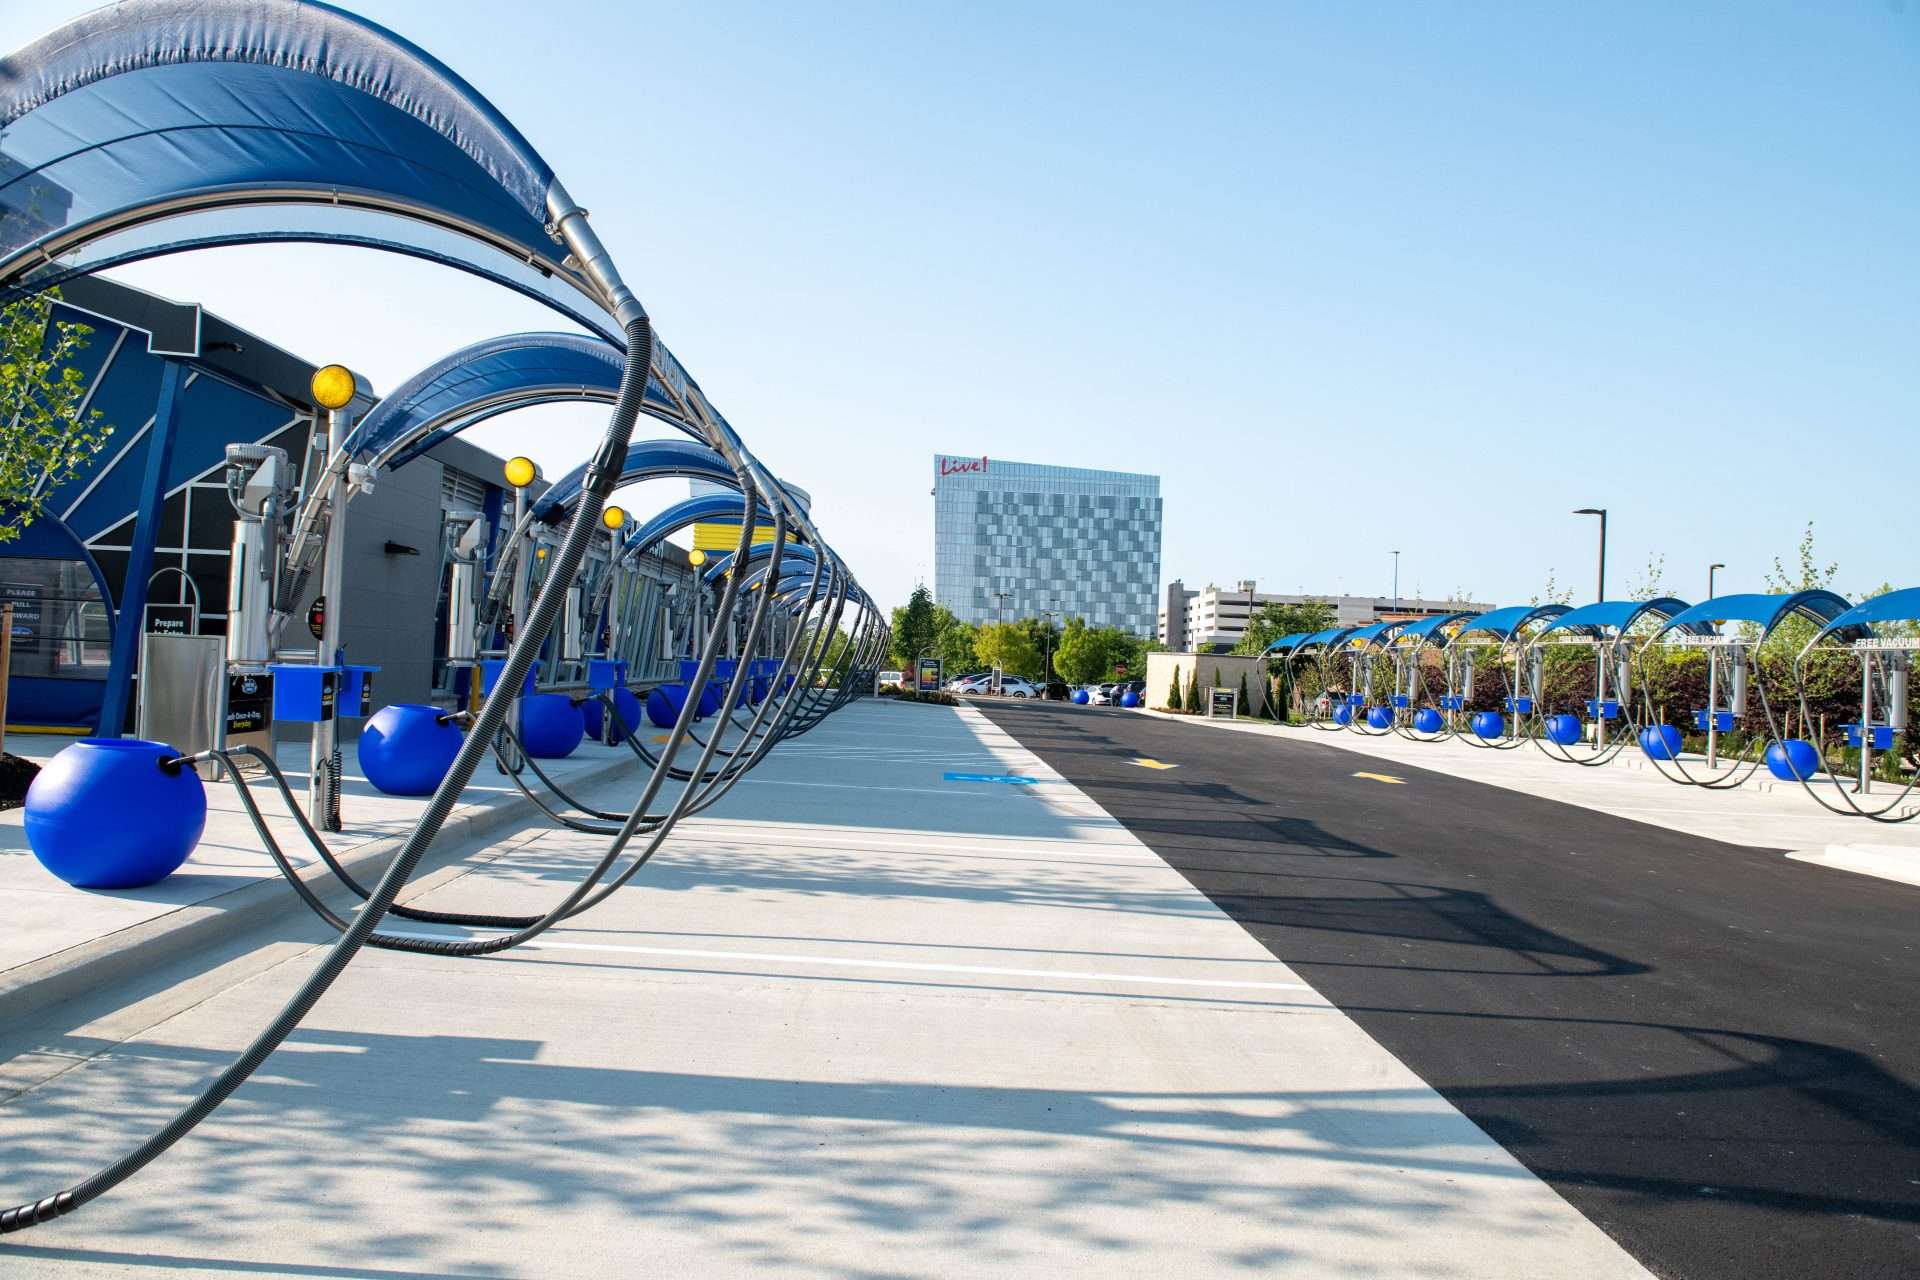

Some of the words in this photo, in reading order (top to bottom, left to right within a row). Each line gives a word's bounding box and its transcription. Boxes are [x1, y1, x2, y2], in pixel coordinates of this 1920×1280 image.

[941, 455, 988, 475] Live!
[155, 618, 184, 629] Prepare
[1856, 638, 1879, 649] FREE
